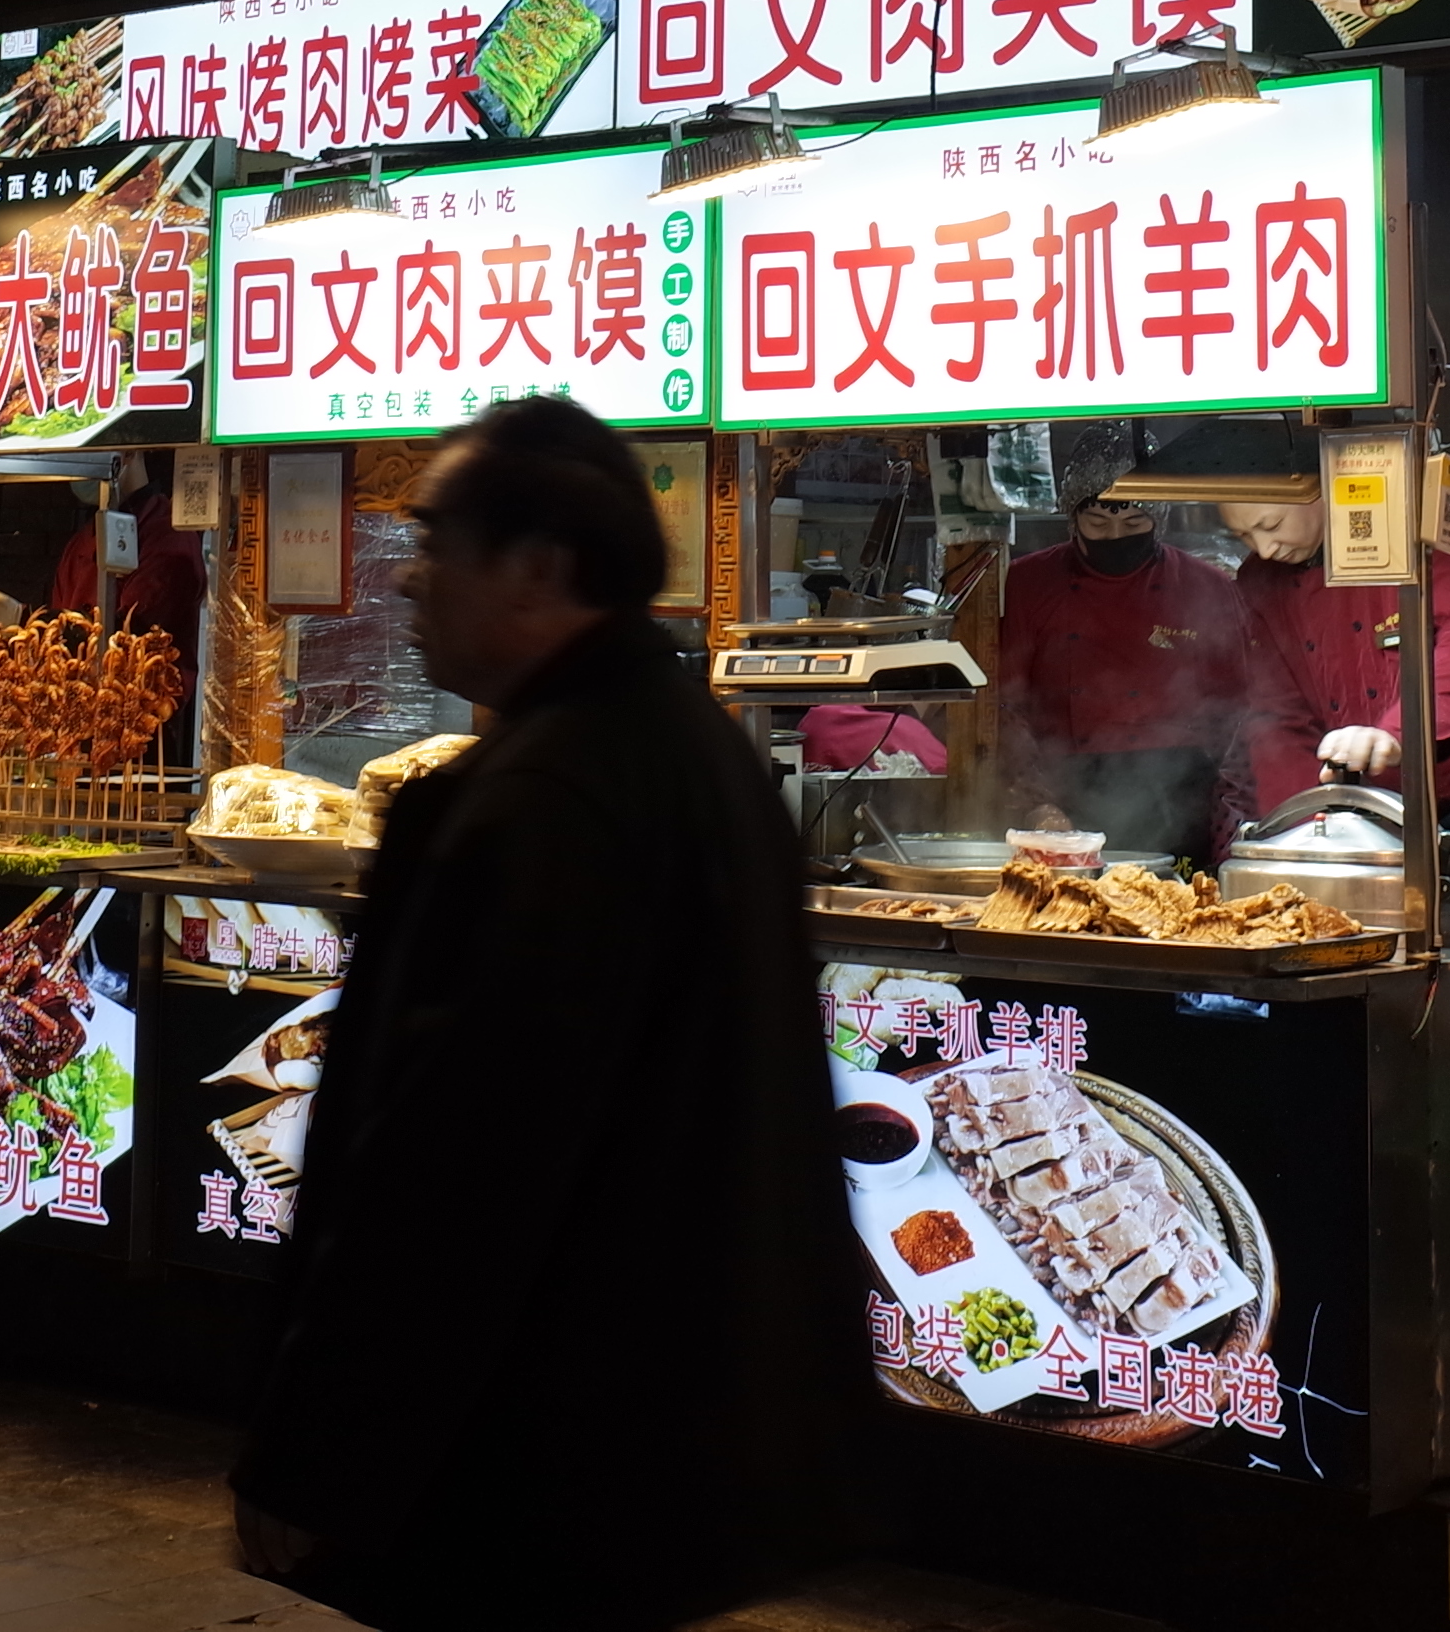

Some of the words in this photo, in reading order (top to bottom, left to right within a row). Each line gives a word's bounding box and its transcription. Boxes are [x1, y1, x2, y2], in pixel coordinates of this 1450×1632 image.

[122, 6, 483, 152] 风味烤肉烤菜
[232, 221, 647, 382] 回文肉夹馍
[664, 216, 693, 408] 手工制作
[742, 181, 1350, 394] 回文手抓羊肉
[327, 390, 433, 422] 真空包装
[197, 1169, 297, 1244] 真空
